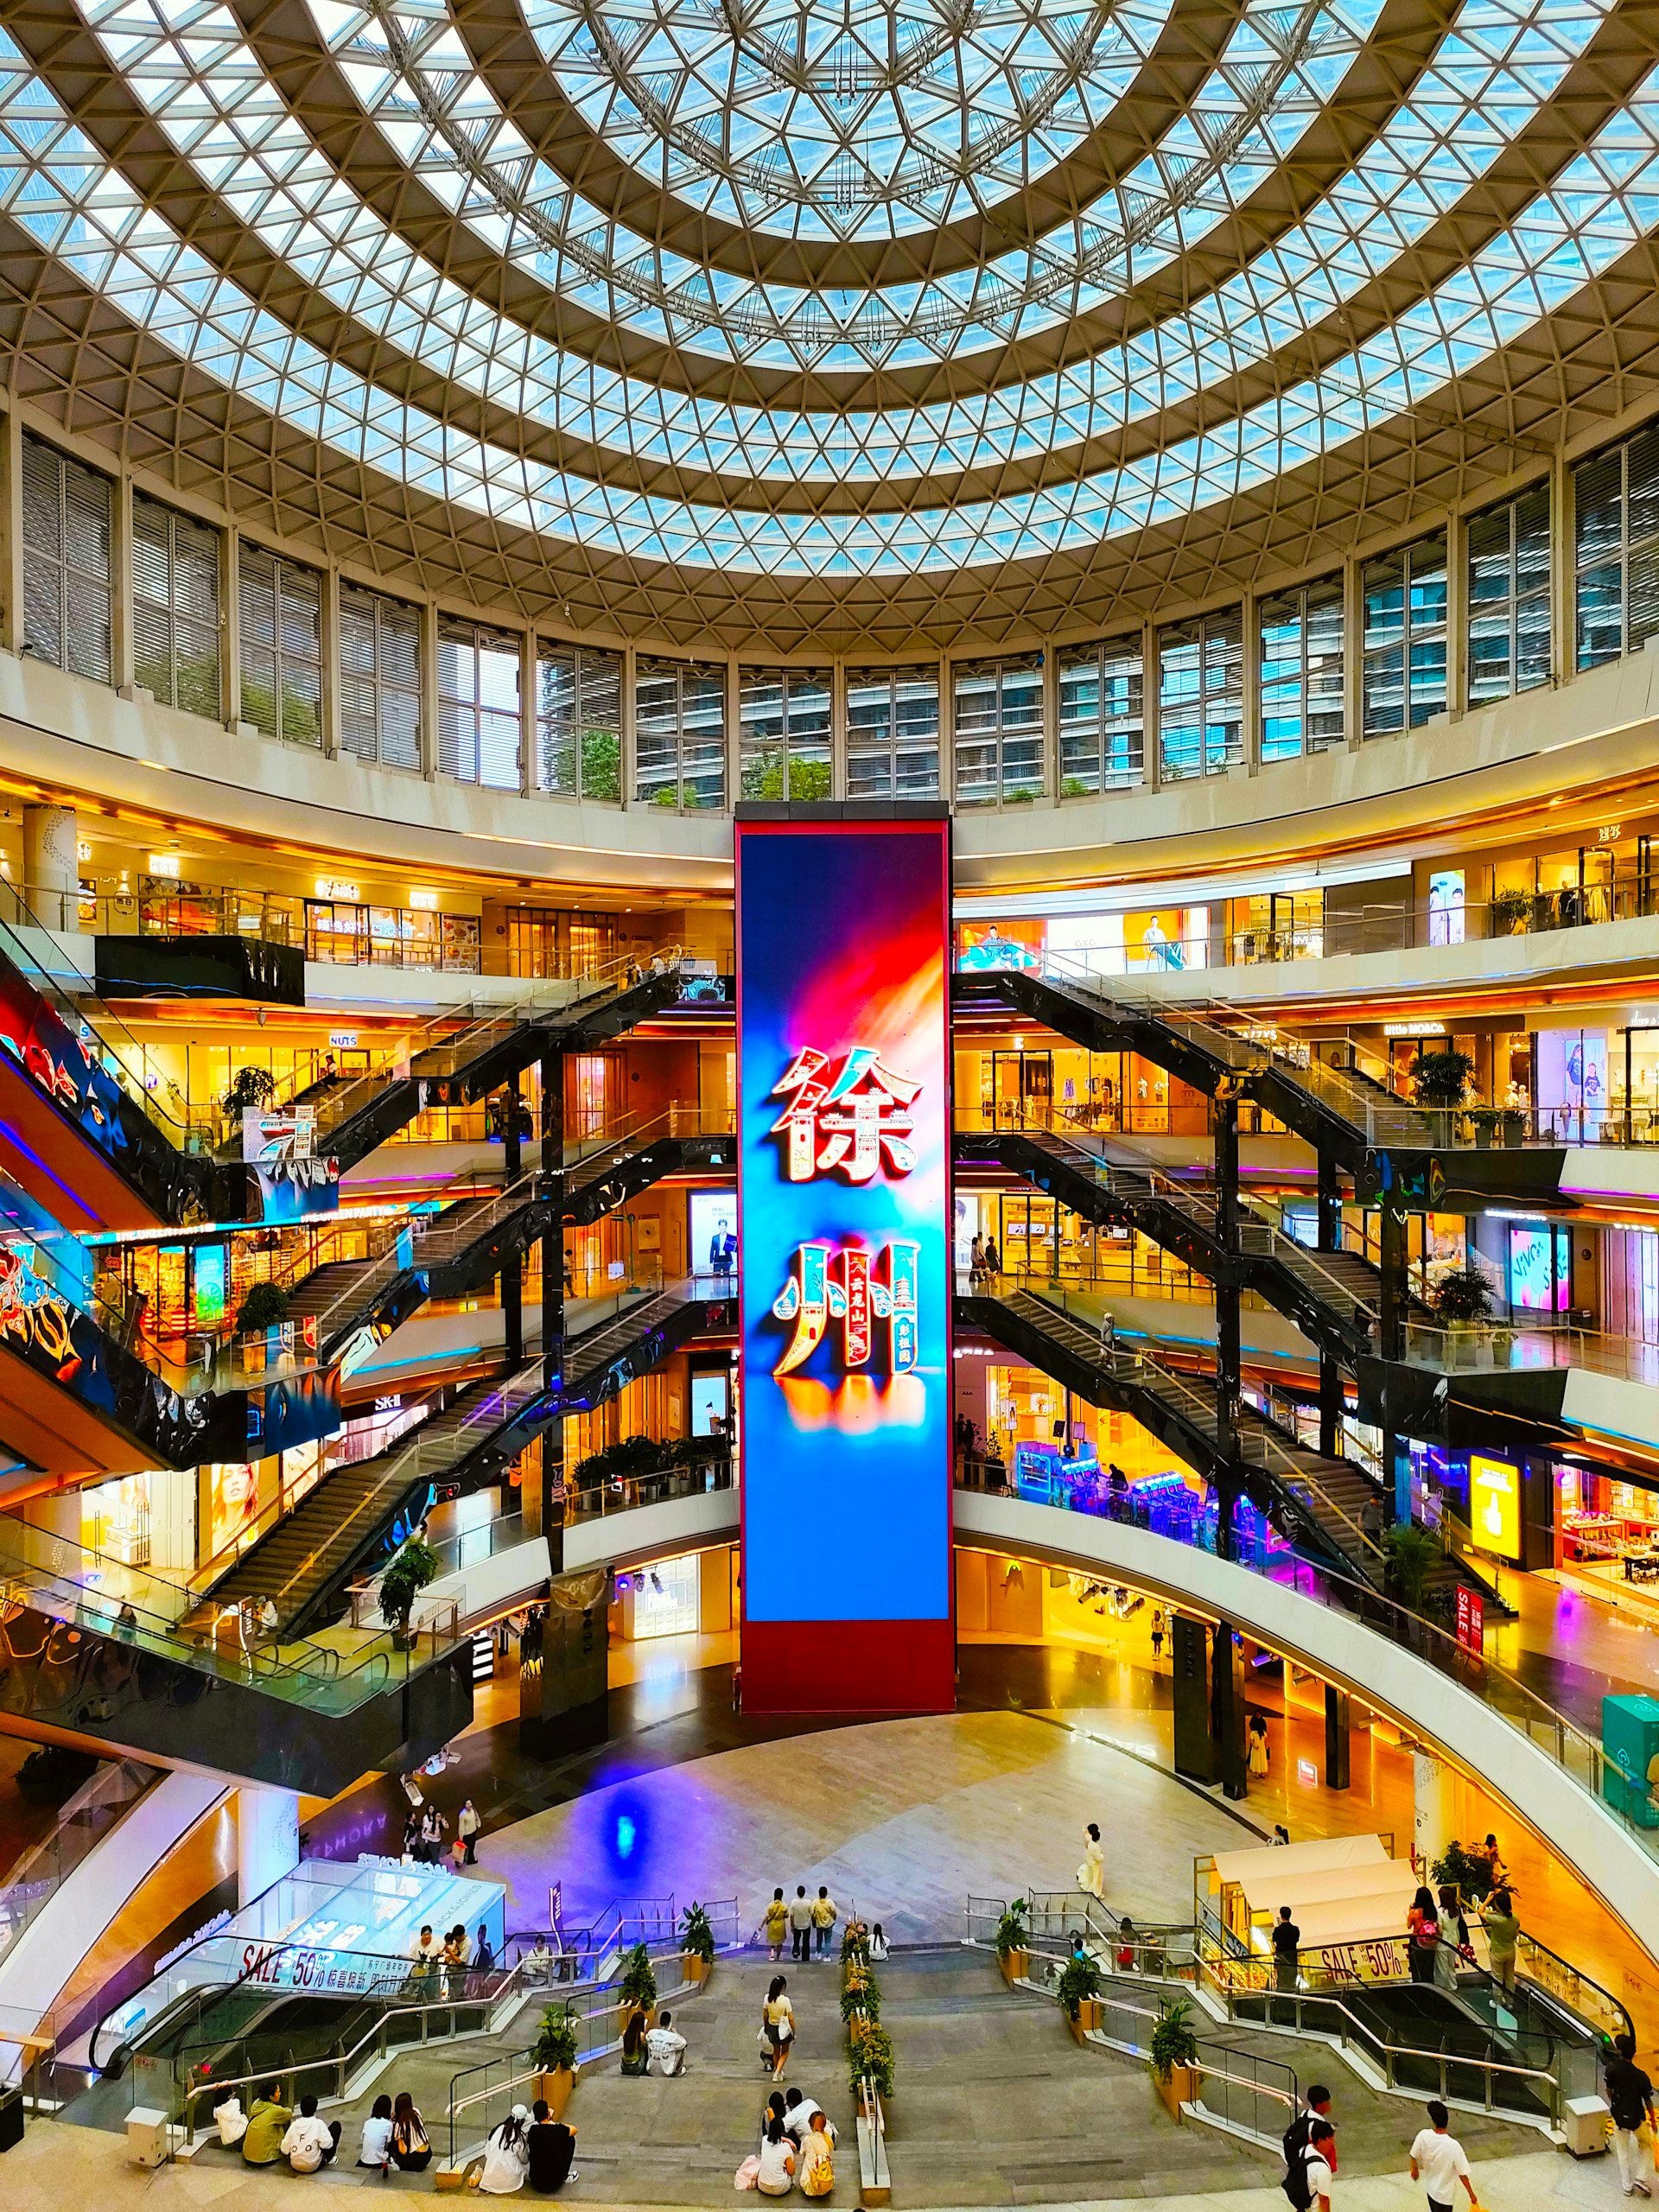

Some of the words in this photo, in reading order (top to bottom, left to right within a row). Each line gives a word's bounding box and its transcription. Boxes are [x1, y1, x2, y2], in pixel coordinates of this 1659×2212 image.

[330, 1035, 357, 1047] NUTS
[1384, 1024, 1408, 1036] little
[354, 1205, 384, 1218] PARTY
[850, 1277, 865, 1323] 云龙山
[899, 1324, 912, 1363] 彭祖园
[374, 1394, 401, 1411] SK-II
[1458, 1591, 1468, 1633] SALE
[238, 1944, 285, 1984] SALE
[293, 1951, 325, 1988] 50%
[1322, 1948, 1361, 1981] SALE
[1367, 1942, 1402, 1978] 50%
[327, 1969, 366, 1991] 惊喜焕新
